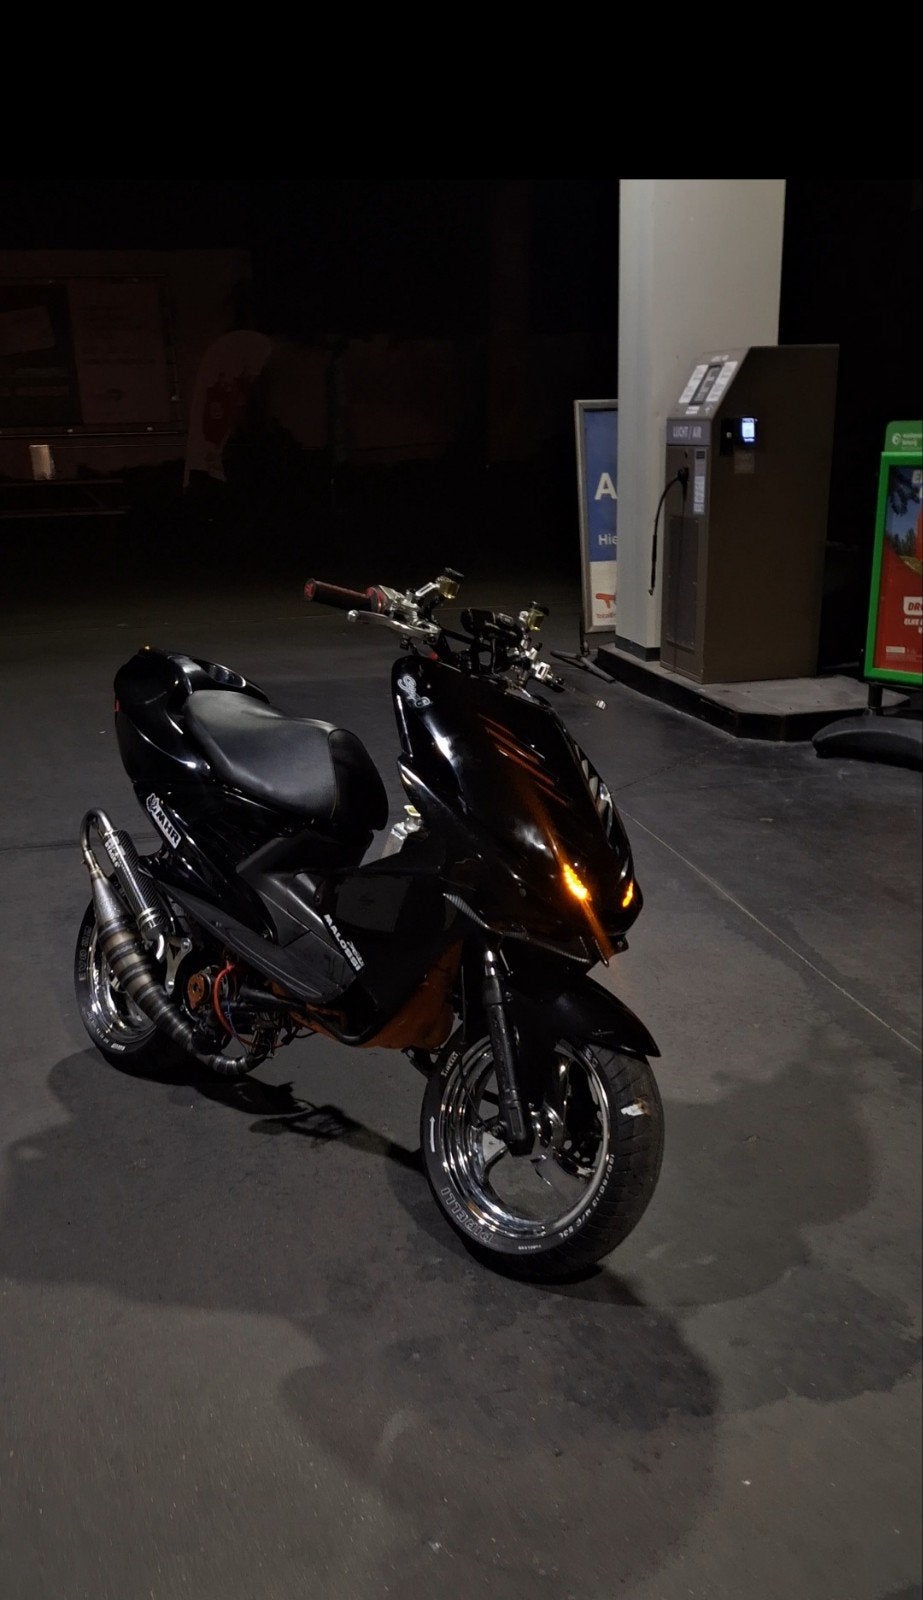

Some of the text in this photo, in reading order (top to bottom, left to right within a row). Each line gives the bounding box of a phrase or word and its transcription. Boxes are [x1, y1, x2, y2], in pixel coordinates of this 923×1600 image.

[692, 426, 702, 438] AIR
[155, 810, 179, 843] MHR
[322, 913, 362, 971] MALOSSI
[441, 1187, 493, 1243] PIRELLI
